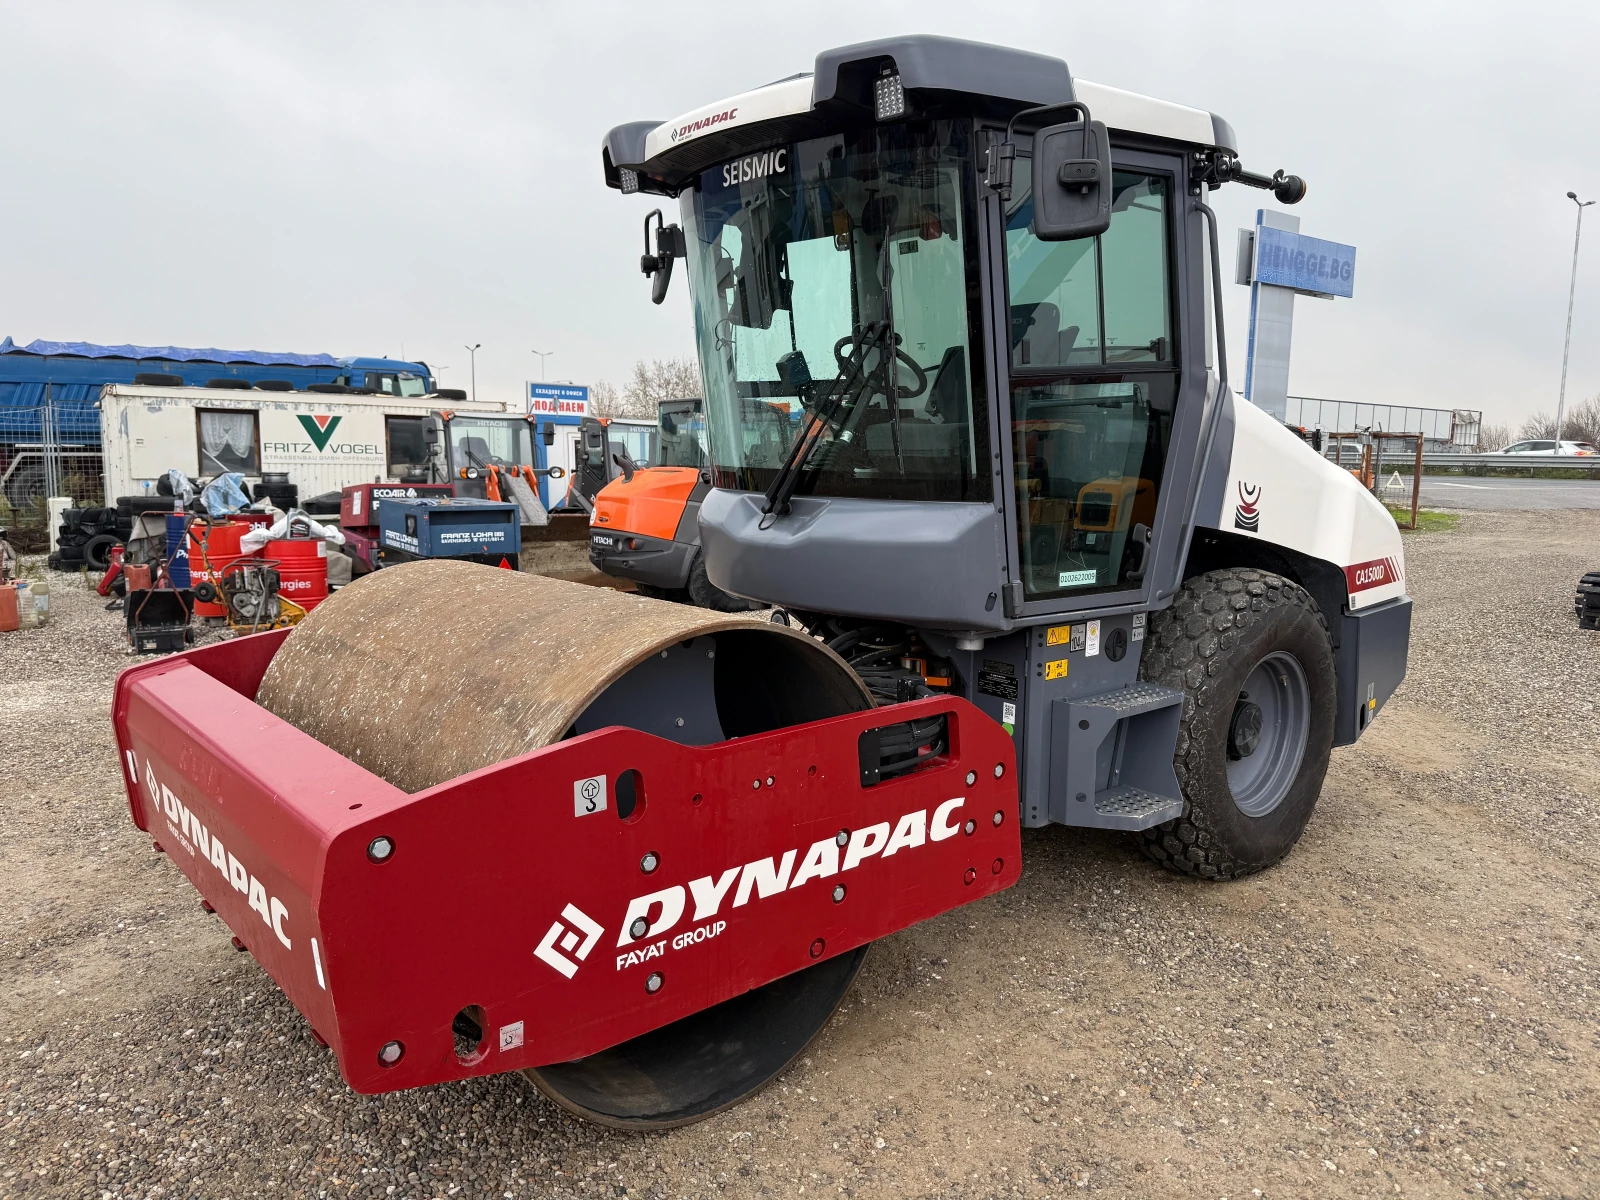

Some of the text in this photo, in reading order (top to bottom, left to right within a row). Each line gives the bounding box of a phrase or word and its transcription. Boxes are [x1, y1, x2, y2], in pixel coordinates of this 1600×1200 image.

[679, 108, 738, 137] DYNAPAC
[722, 148, 787, 188] SEISMIC
[559, 401, 585, 413] НАЕМ
[477, 420, 508, 428] HITACHI
[263, 442, 384, 455] FRITZ VOGEL
[373, 489, 406, 498] ECOAIR
[249, 521, 267, 531] obil
[593, 535, 613, 546] HITACHI
[1355, 564, 1385, 585] CA1500D
[161, 782, 292, 950] DYNAPAC
[616, 797, 965, 948] DYNAPAC
[616, 919, 727, 971] FAYAT GROUP
